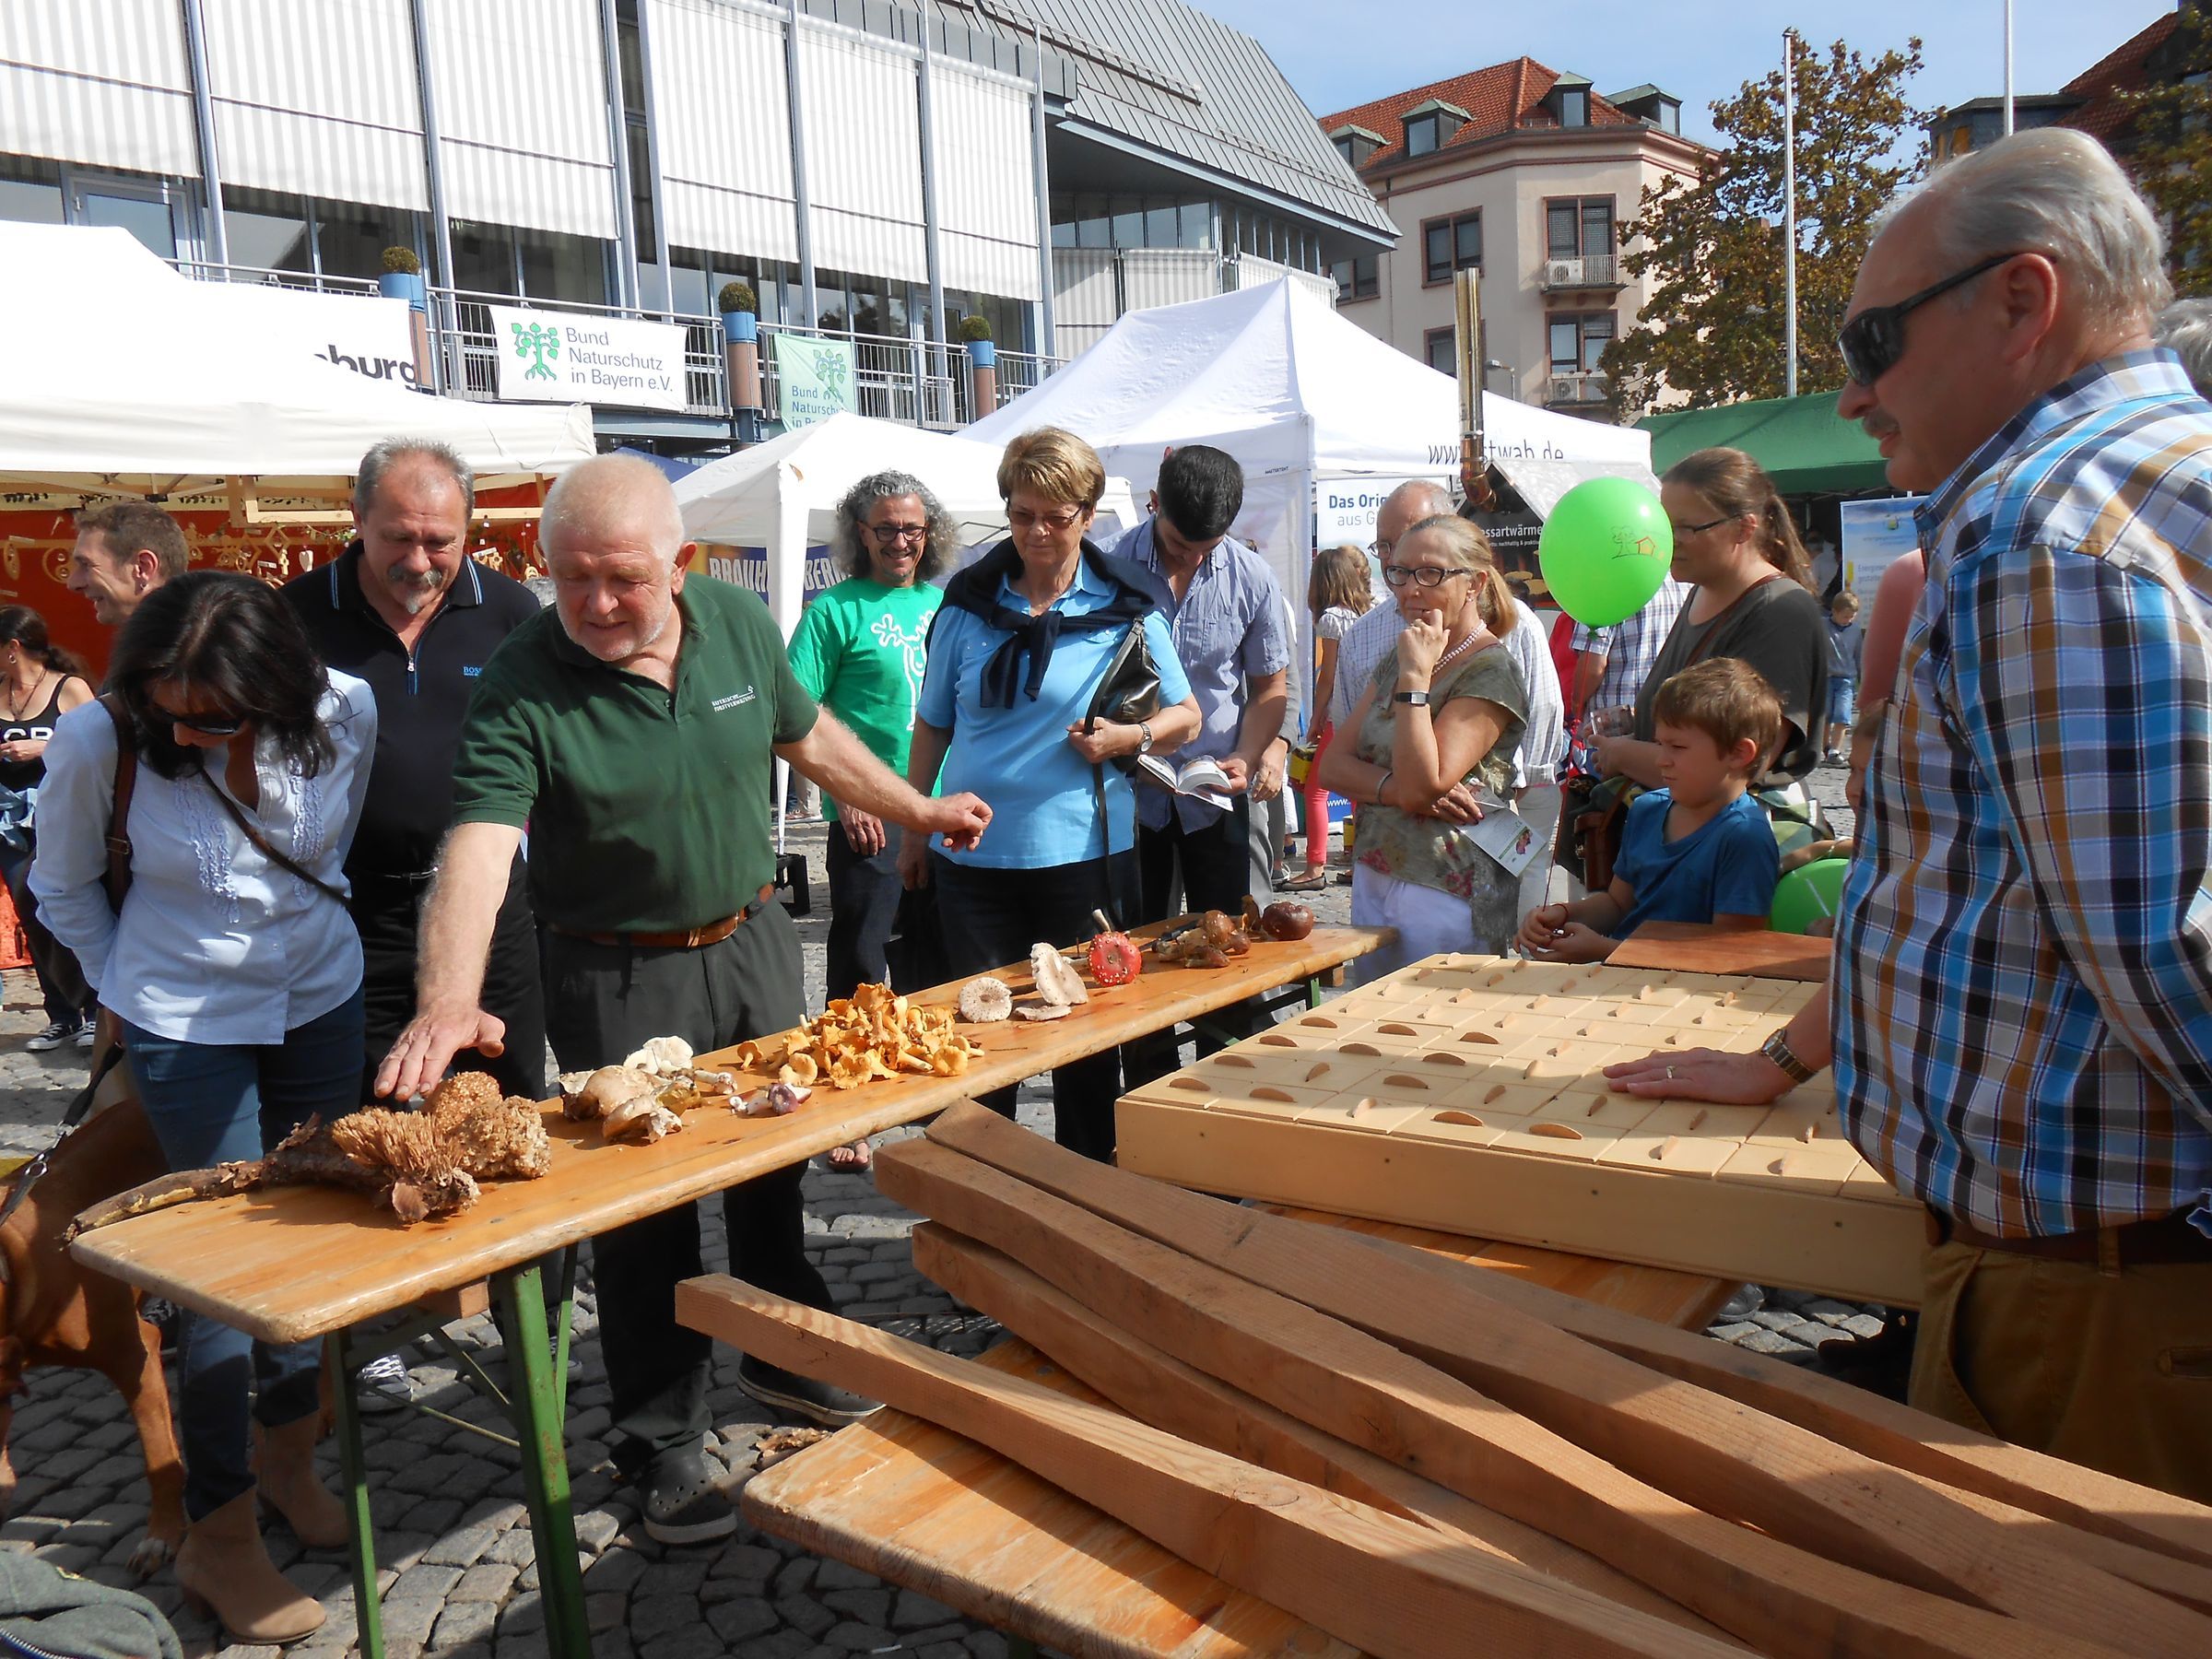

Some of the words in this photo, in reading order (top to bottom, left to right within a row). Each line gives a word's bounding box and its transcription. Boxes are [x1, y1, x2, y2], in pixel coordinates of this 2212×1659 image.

[566, 327, 608, 346] Bund
[569, 347, 663, 371] Naturschutz
[313, 344, 419, 393] burg
[571, 367, 585, 383] in
[591, 369, 643, 390] Bayern
[648, 375, 673, 392] e.V.
[792, 385, 818, 398] Bund
[792, 417, 802, 428] in
[1329, 495, 1355, 509] Das
[1337, 515, 1362, 526] aus
